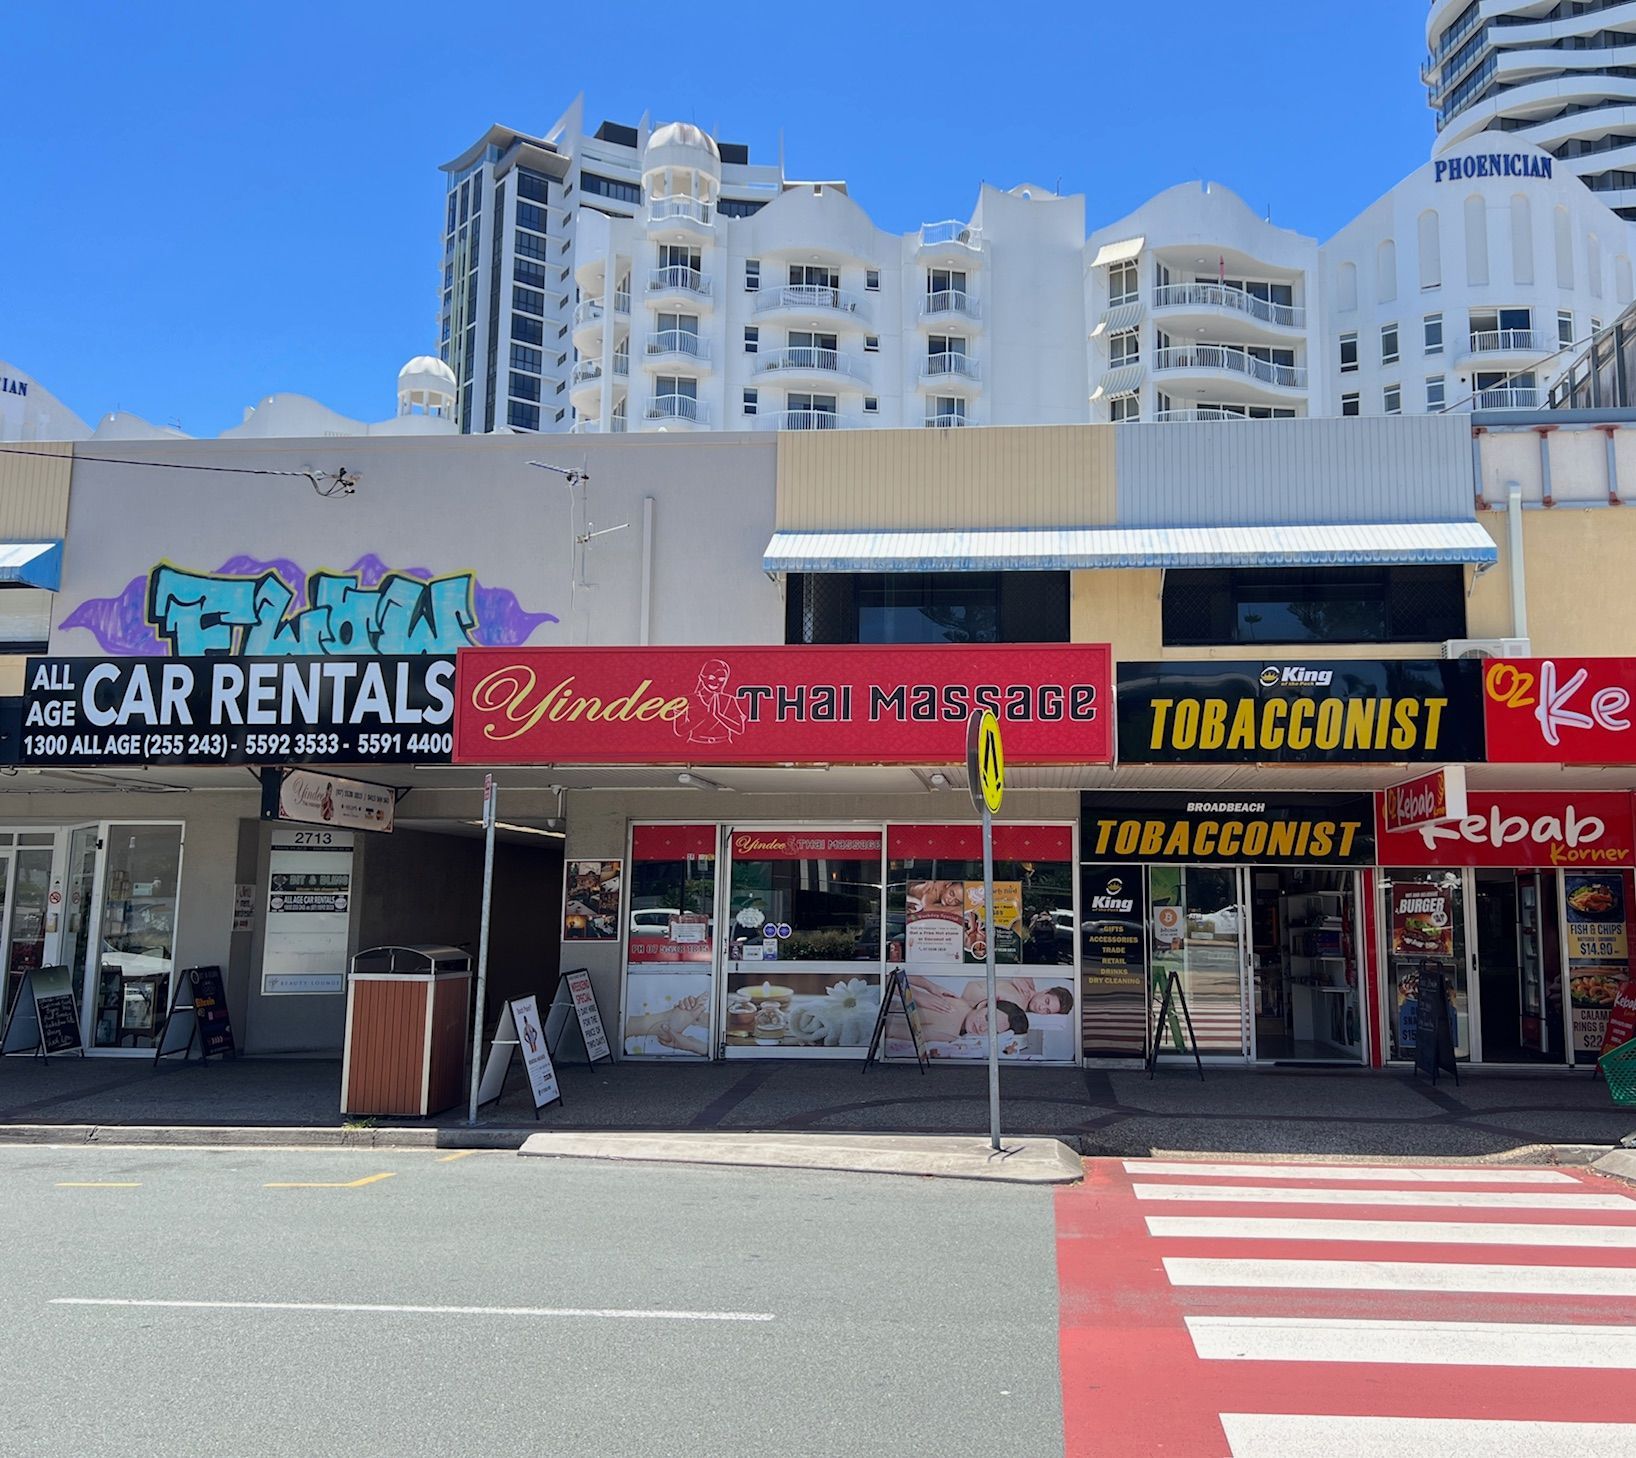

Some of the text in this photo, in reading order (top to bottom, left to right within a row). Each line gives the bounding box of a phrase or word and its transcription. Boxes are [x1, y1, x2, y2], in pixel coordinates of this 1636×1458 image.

[1434, 153, 1553, 183] PHOENICIAN
[0, 377, 28, 397] IAN
[31, 664, 75, 691] ALL
[1280, 666, 1334, 686] King
[82, 660, 456, 727] CAR RENTALS
[471, 664, 689, 741] Yindee
[25, 700, 75, 727] AGE
[1150, 697, 1448, 750] TOBACCONIST
[24, 735, 68, 756] 1300
[70, 735, 102, 755] ALL
[104, 734, 141, 755] AGE
[144, 733, 184, 757] (255
[245, 733, 290, 755] 5592
[294, 733, 339, 754] 3533
[357, 733, 402, 753] 5591
[407, 733, 453, 753] 4400
[1186, 802, 1266, 813] BROADBEACH
[1396, 784, 1435, 826] Kebab
[295, 832, 333, 845] 2713
[735, 835, 787, 854] Yindee
[1094, 820, 1362, 857] TOBACCONIST
[1550, 842, 1630, 866] Korner
[1091, 895, 1134, 912] King
[1400, 897, 1446, 914] BURGER
[1103, 925, 1125, 933] GIFTS
[1570, 924, 1588, 935] FISH
[1597, 924, 1622, 935] CHIPS
[1088, 935, 1139, 943] ACCESSORIES
[1102, 946, 1127, 954] TRADE
[1101, 957, 1127, 965] RETAIL
[1104, 977, 1141, 985] CLEANING
[1573, 1021, 1598, 1032] RINGS
